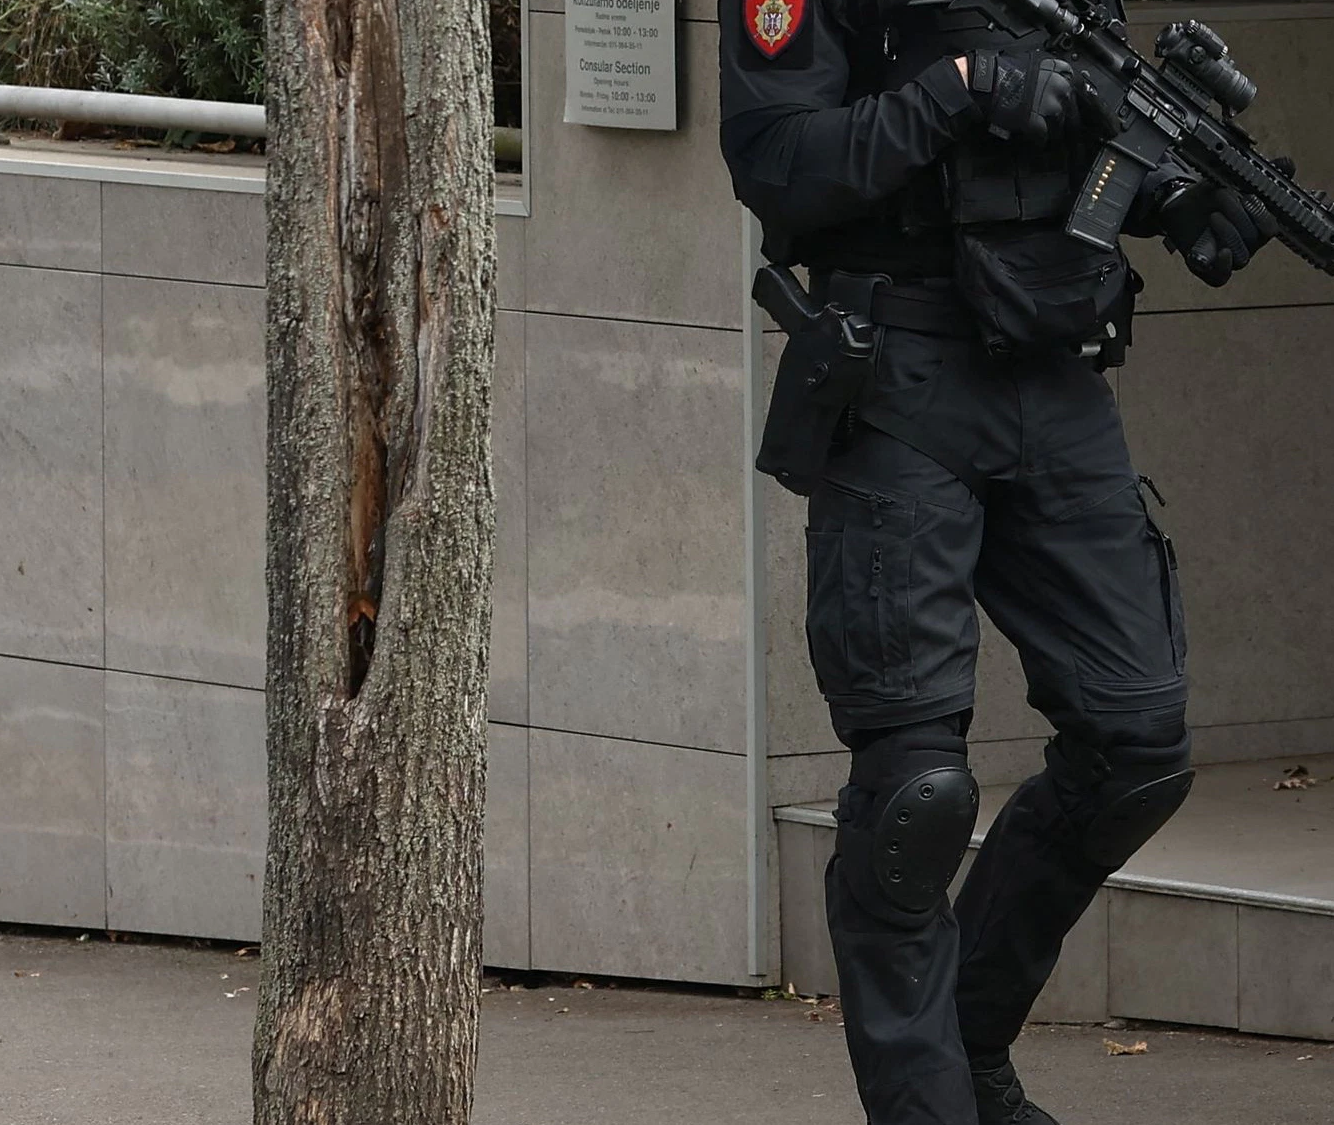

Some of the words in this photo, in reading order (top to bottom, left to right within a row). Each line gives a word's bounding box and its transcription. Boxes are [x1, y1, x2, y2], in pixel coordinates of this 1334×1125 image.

[613, 27, 631, 37] 10:00
[638, 28, 659, 38] 13:00
[579, 58, 613, 73] Consular
[615, 61, 651, 75] Section
